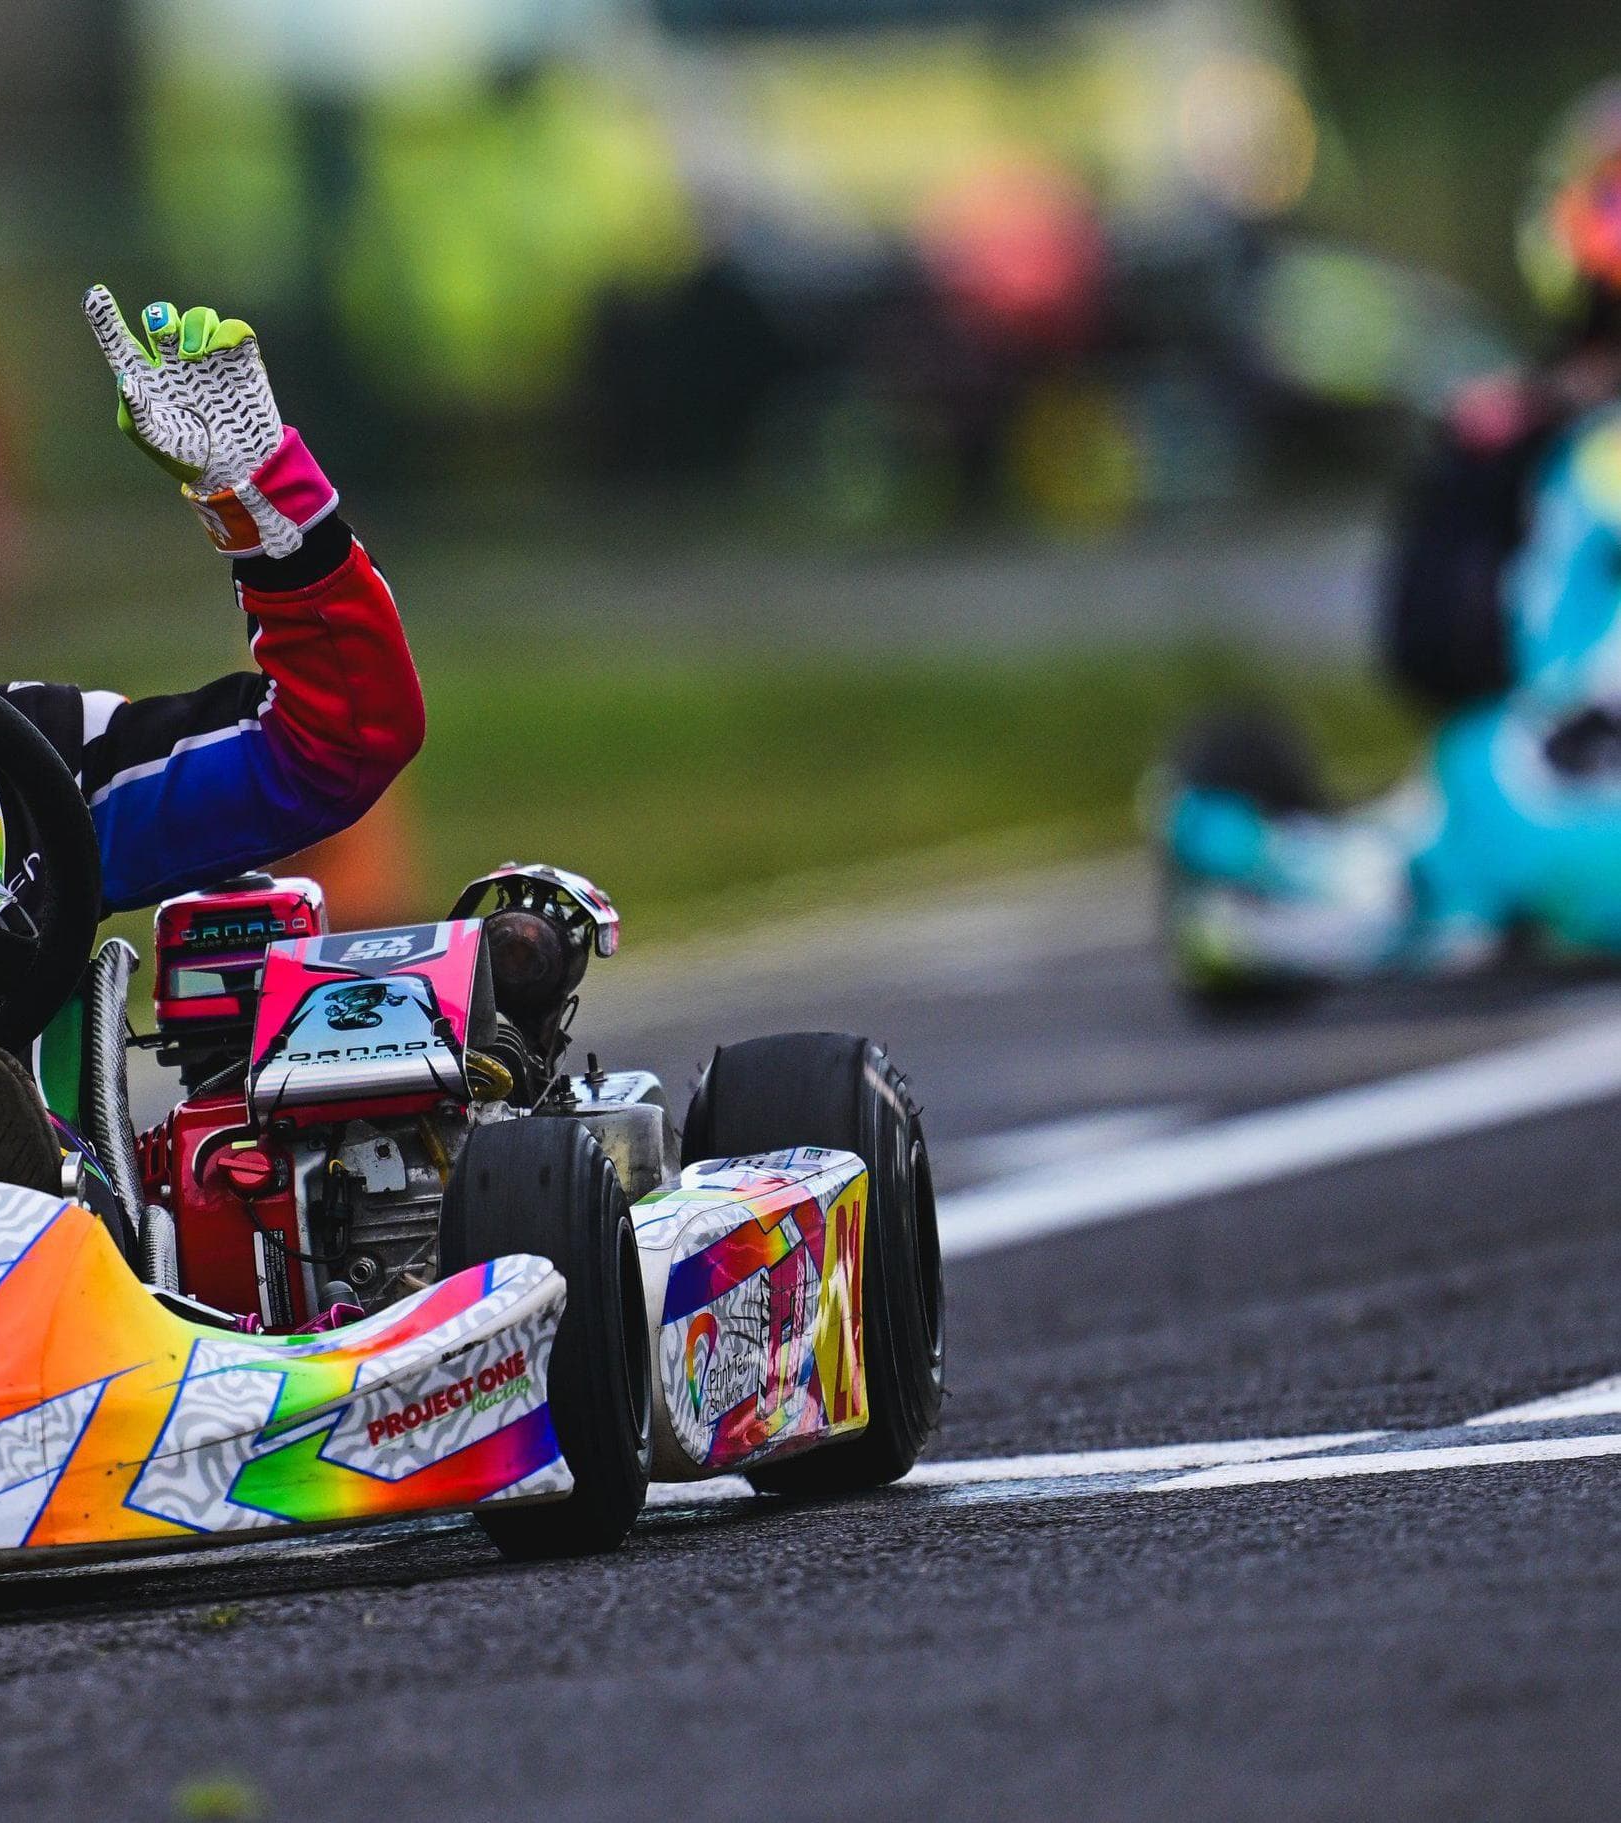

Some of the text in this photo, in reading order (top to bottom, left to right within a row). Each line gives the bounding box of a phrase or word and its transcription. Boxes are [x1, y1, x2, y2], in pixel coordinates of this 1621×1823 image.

[180, 917, 307, 941] ORNADO
[347, 934, 416, 953] GX
[367, 1350, 526, 1446] PROJECT ONE
